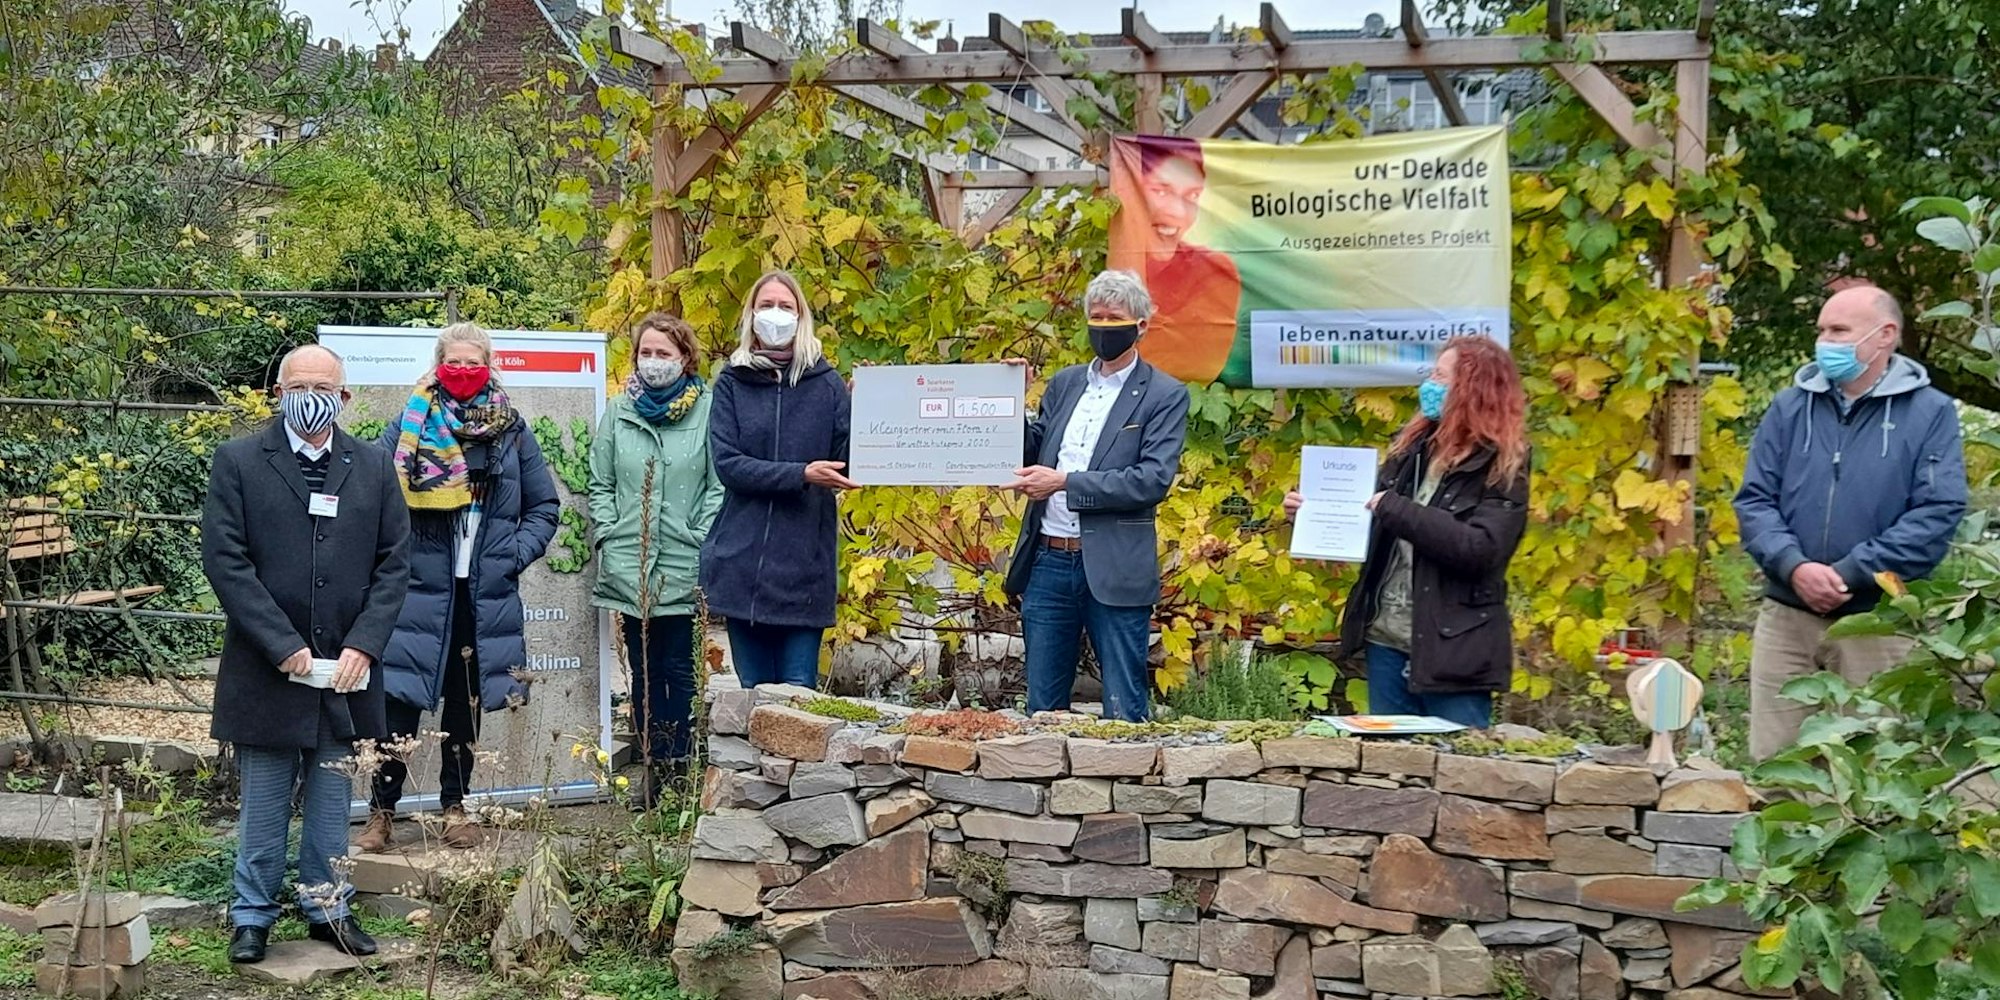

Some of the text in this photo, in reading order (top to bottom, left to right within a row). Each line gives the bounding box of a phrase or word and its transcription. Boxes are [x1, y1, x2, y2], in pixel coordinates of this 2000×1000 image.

[1354, 156, 1488, 181] UN-Dekade
[1251, 185, 1489, 219] Biologische Vielfalt
[1280, 229, 1491, 251] Ausgezeichnetes Projekt
[493, 356, 526, 367] dt Köln
[925, 403, 943, 412] EUR
[958, 402, 997, 417] 1.500
[1322, 460, 1358, 472] Urkunde
[522, 604, 569, 621] hern,
[526, 653, 581, 671] tklima
